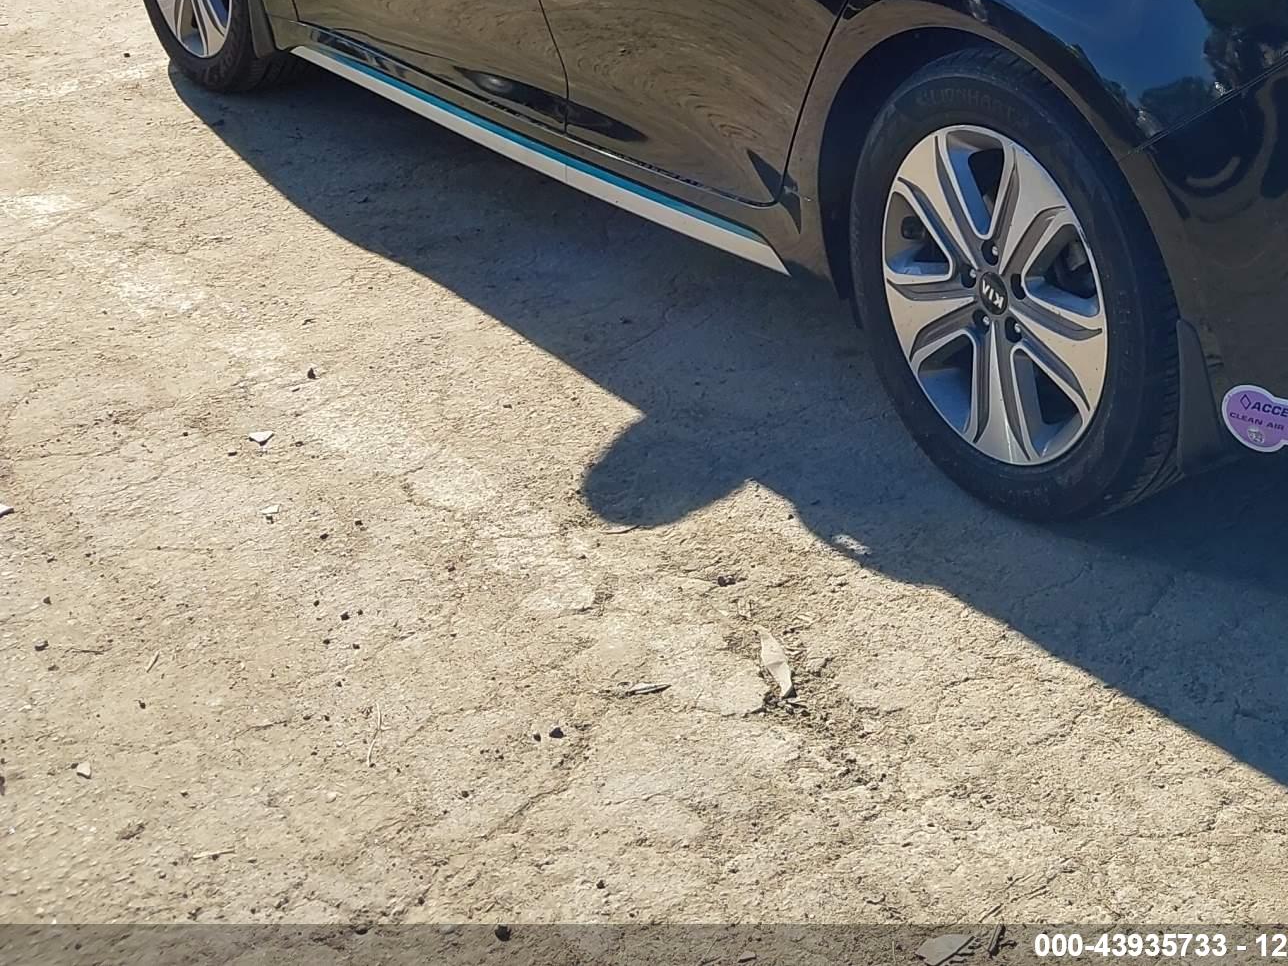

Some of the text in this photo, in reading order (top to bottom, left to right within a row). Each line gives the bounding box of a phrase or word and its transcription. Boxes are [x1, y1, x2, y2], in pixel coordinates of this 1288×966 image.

[982, 278, 1005, 310] KIA
[1229, 412, 1263, 426] CLEAN
[1266, 421, 1285, 431] AIR
